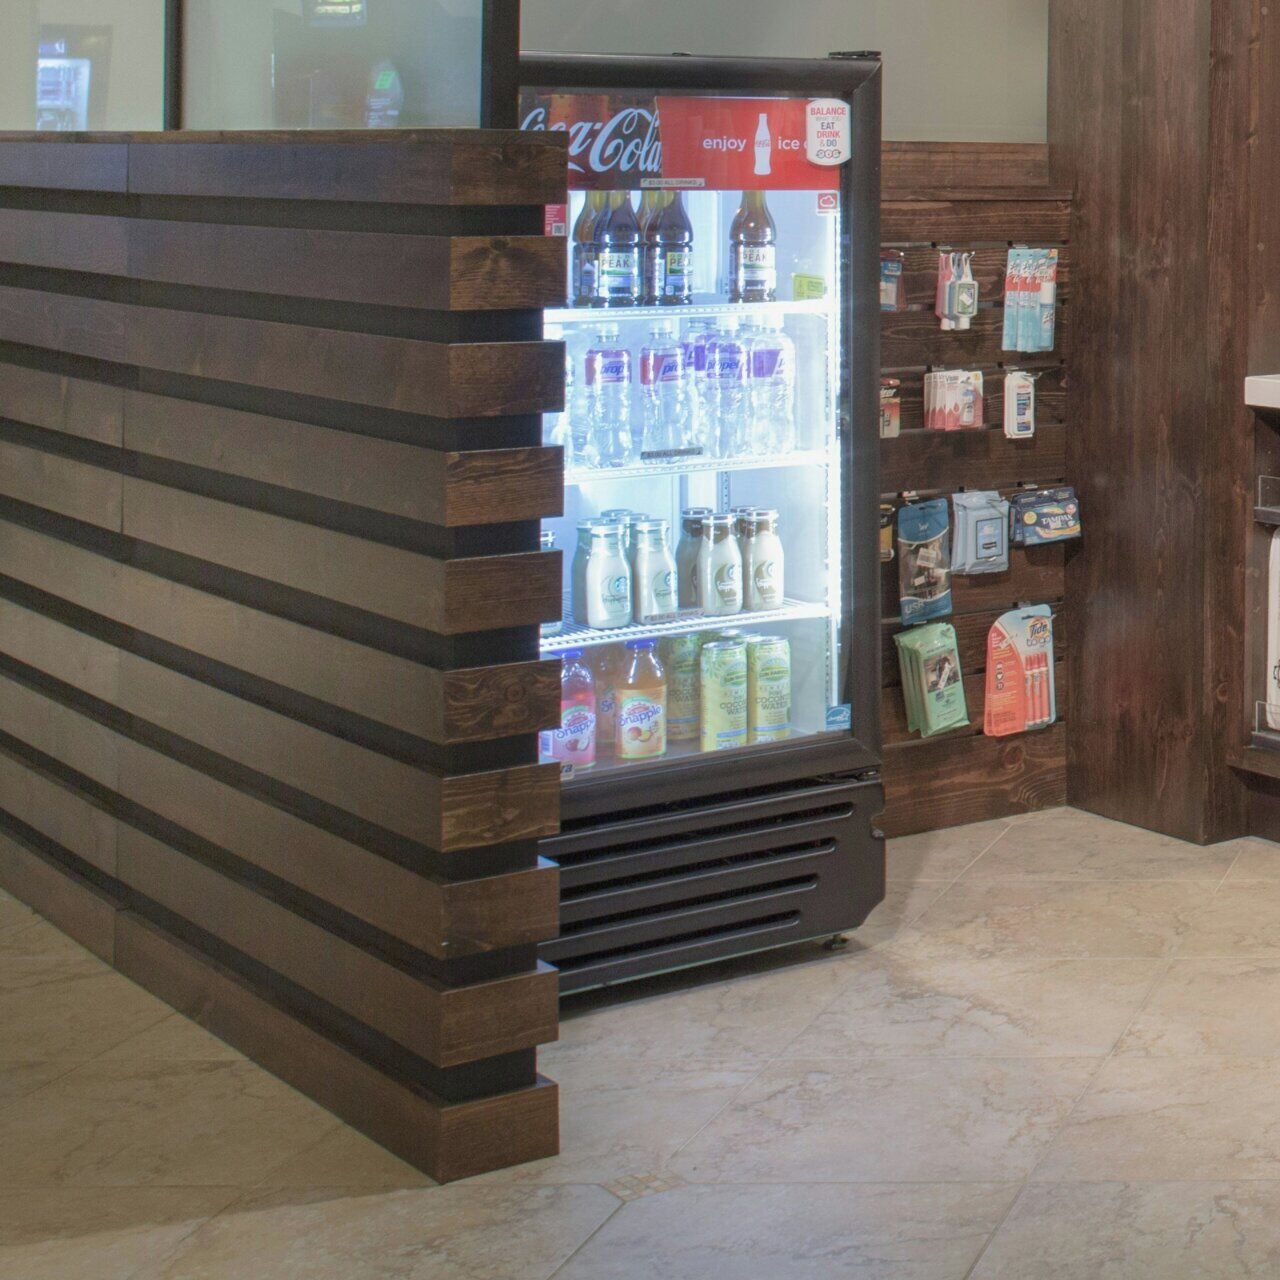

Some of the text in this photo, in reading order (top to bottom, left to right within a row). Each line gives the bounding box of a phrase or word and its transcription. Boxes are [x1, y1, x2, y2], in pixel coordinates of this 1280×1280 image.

[811, 107, 846, 116] BALANCE
[820, 121, 835, 130] EAT
[816, 130, 841, 139] DRINK
[703, 136, 746, 152] enjoy
[778, 136, 800, 150] ice
[826, 139, 838, 148] DO
[601, 260, 631, 268] PEAK
[1029, 622, 1048, 638] Tide
[619, 705, 662, 726] Snapple
